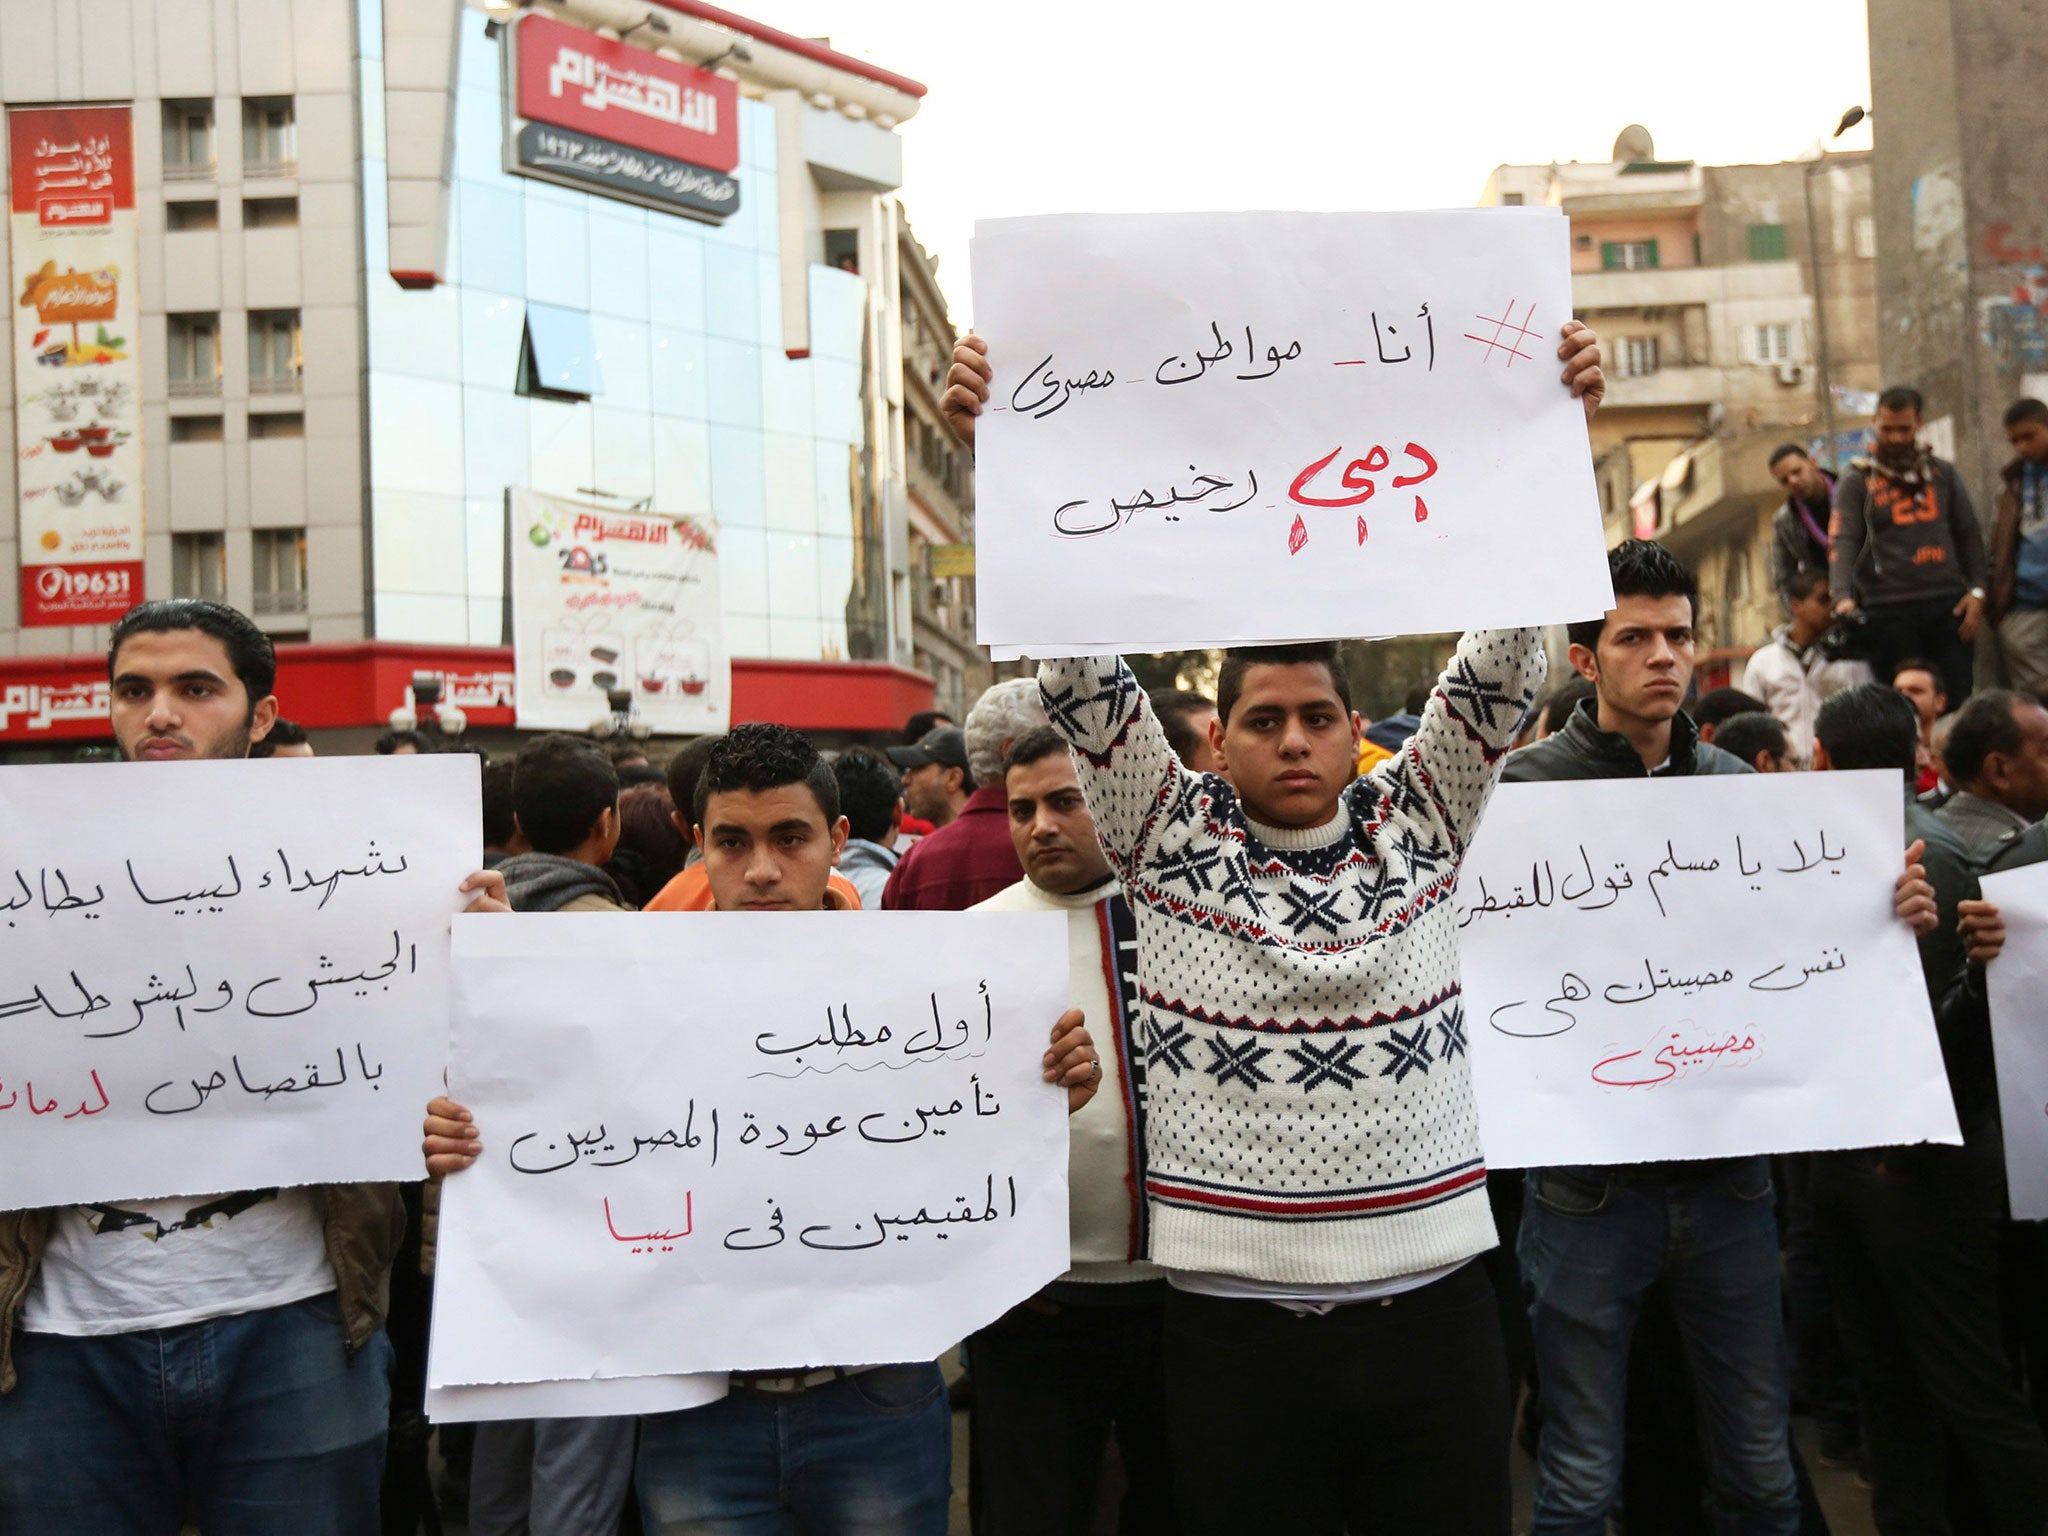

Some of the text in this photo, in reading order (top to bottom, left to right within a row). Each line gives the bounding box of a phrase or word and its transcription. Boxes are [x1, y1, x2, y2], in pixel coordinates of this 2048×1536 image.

[1050, 464, 1258, 539] رخيص
[64, 569, 130, 594] 19631
[126, 855, 241, 915] ليبيا
[259, 841, 407, 910] شهداء
[1562, 844, 1633, 910] قول
[1648, 840, 1719, 917] مسلم
[1737, 835, 1762, 891] يا
[1777, 830, 1845, 875] يلا
[246, 930, 416, 1017] الجيش
[1749, 948, 1845, 991] نفس
[756, 979, 991, 1063] أول مطلب
[145, 1043, 382, 1115] بالقصاص
[510, 1074, 1000, 1174] تأمين عودة المصريين
[604, 1190, 692, 1253] ليبيا
[799, 1174, 1016, 1250] المقيمين
